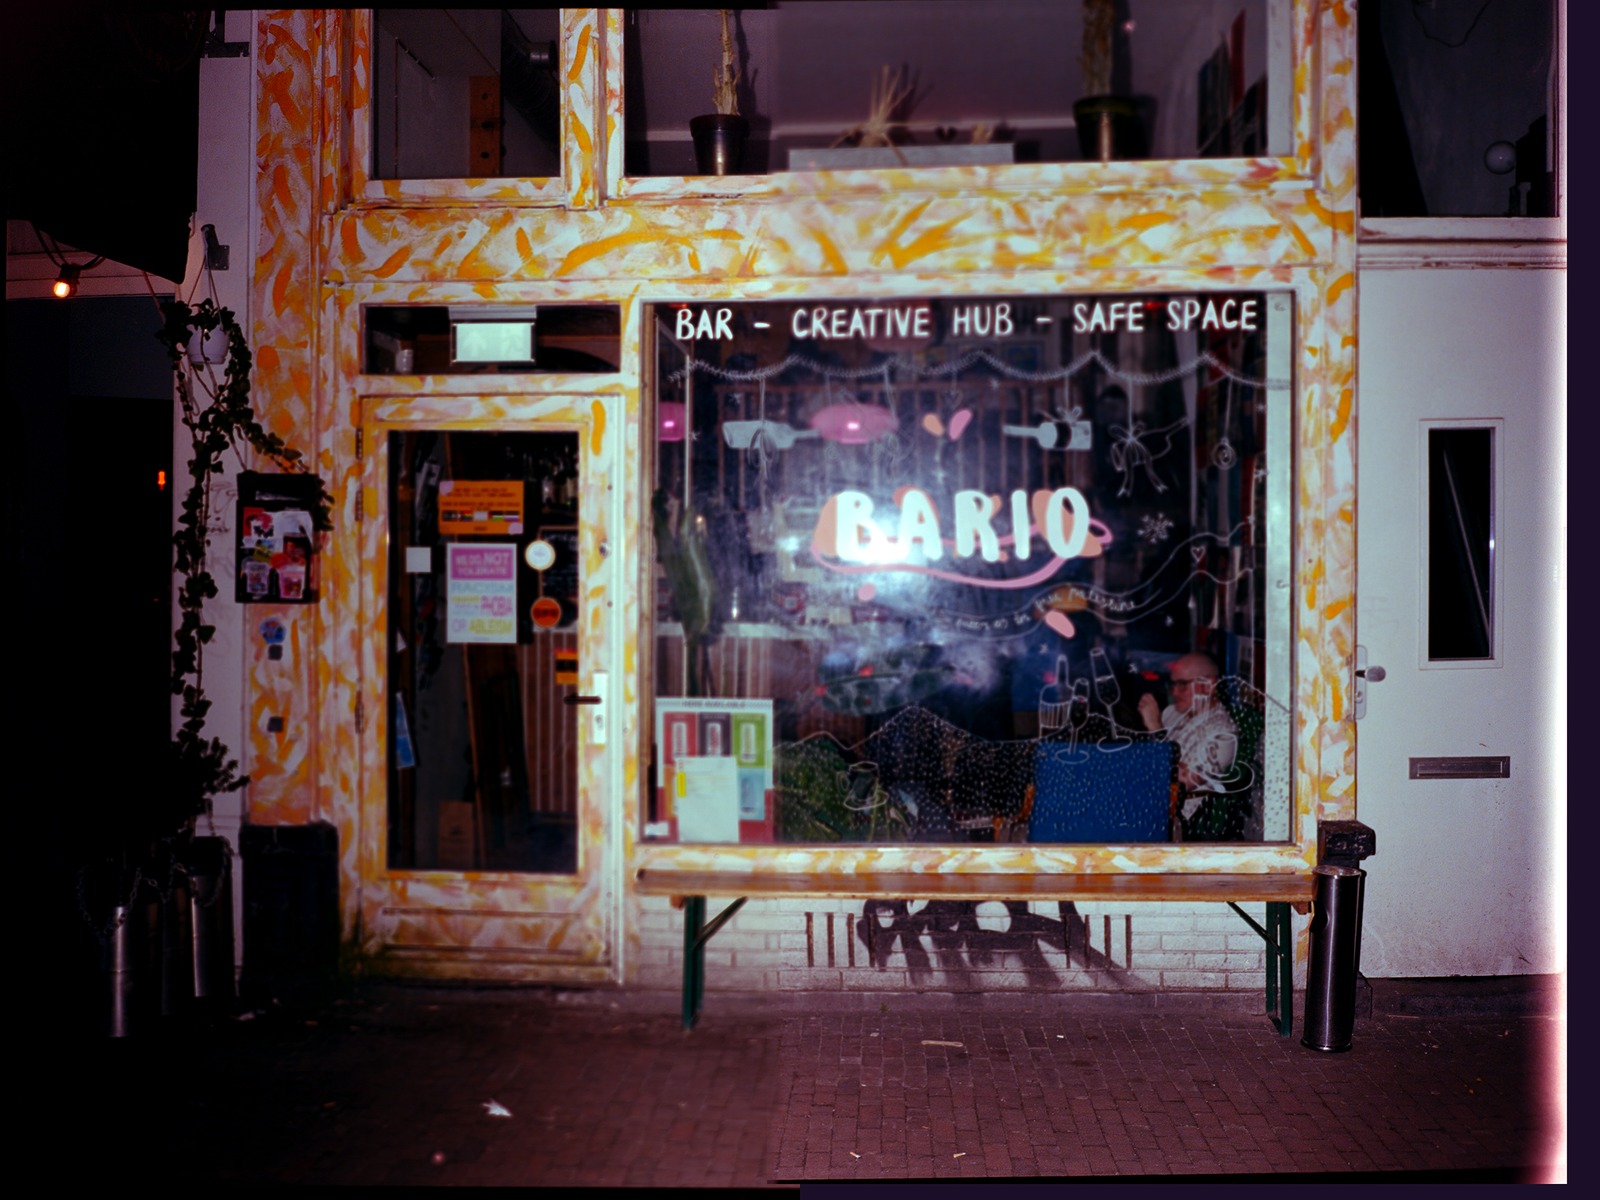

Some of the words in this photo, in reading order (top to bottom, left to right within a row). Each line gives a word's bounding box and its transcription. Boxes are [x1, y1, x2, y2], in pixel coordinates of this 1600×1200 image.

[675, 307, 734, 340] BAR
[792, 306, 930, 338] CREATIVE
[953, 303, 1013, 336] HUB
[1073, 301, 1144, 333] SAFE
[1167, 299, 1257, 331] SPACE
[835, 487, 1090, 562] BARIO
[483, 551, 510, 566] NOT
